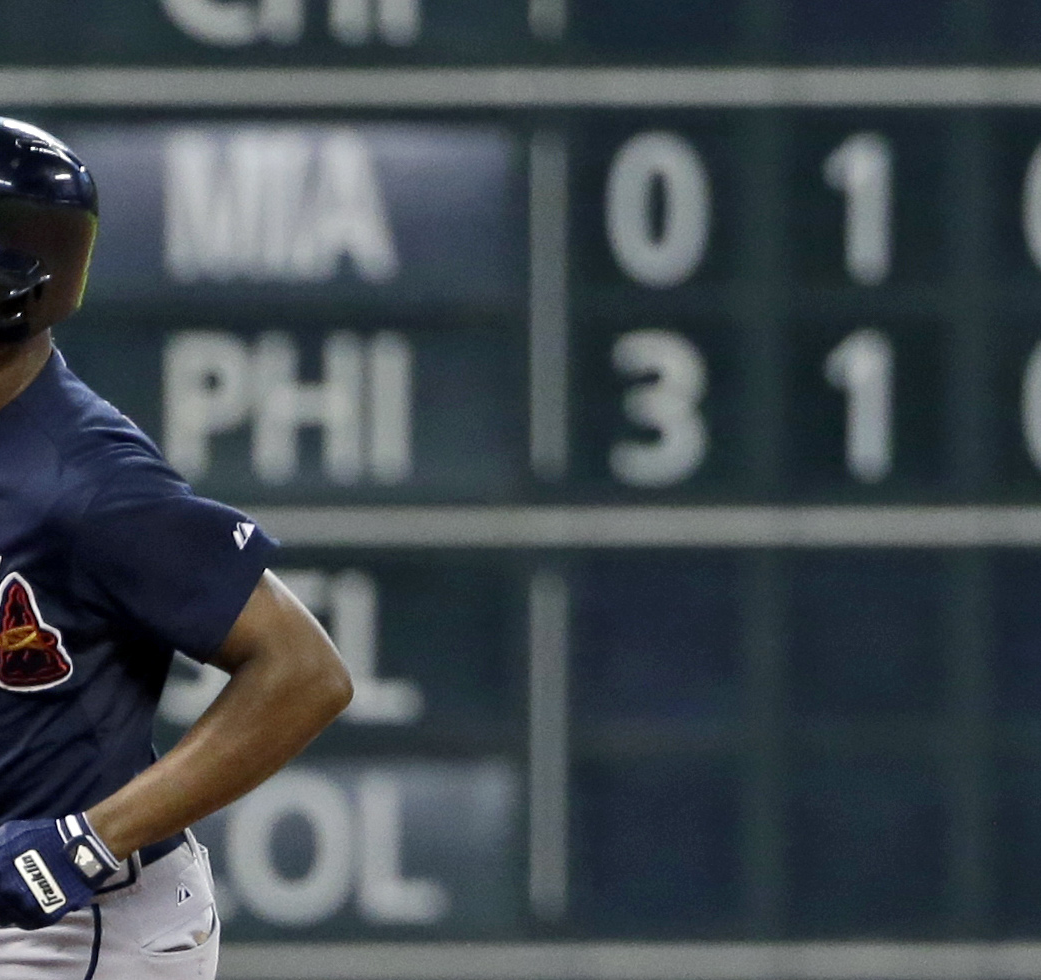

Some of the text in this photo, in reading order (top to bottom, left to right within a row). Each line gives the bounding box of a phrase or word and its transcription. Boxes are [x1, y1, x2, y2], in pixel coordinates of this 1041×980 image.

[162, 128, 399, 284] MIA
[604, 130, 711, 288] 0
[822, 131, 893, 286] 1
[163, 328, 413, 487] PHI
[607, 328, 707, 487] 3
[823, 328, 893, 486] 1
[215, 768, 451, 928] OL
